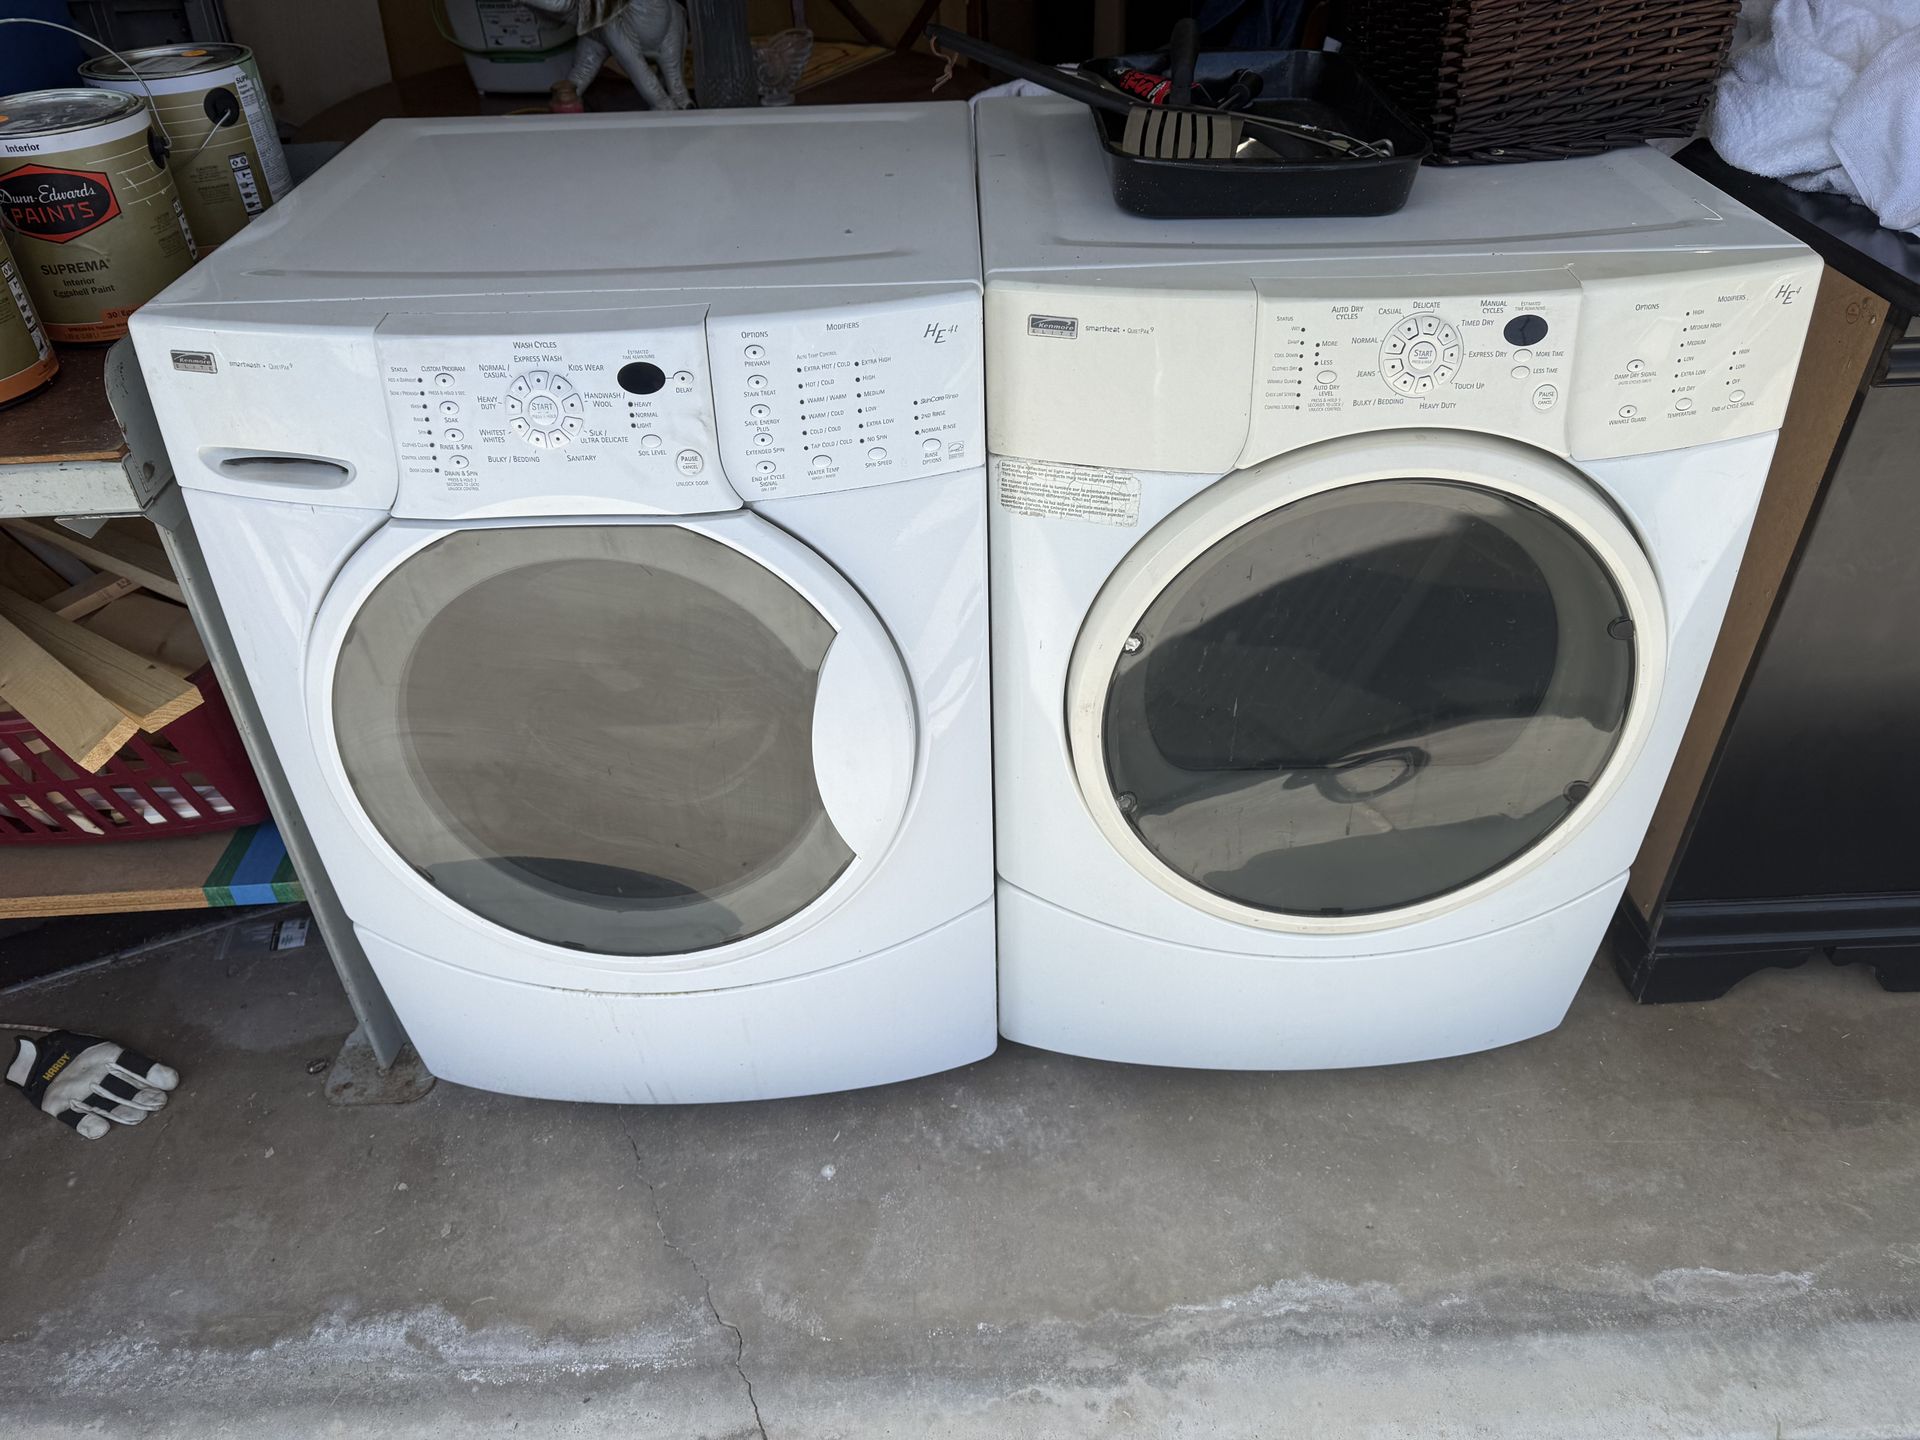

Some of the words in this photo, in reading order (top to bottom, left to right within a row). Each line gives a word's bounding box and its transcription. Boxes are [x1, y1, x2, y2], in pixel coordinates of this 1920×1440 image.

[6, 143, 40, 153] Interior
[0, 182, 96, 204] Dunn-Edwards
[11, 202, 95, 226] PAINTS
[40, 259, 109, 276] SUPREMA
[63, 278, 95, 287] Interior
[53, 288, 89, 298] Eggshell
[91, 284, 115, 295] Paint
[1717, 294, 1746, 303] MODIFIERS
[1635, 303, 1659, 312] OPTIONS
[826, 322, 860, 331] MODIFIERS
[1039, 322, 1074, 331] Kenmore
[1085, 325, 1120, 333] smartheat
[741, 331, 769, 339] OPTIONS
[864, 389, 885, 397] MEDIUM
[532, 403, 553, 411] START
[1667, 410, 1697, 418] TEMPERATURE
[920, 426, 942, 434] NORMAL
[42, 1052, 71, 1081] HARDY
